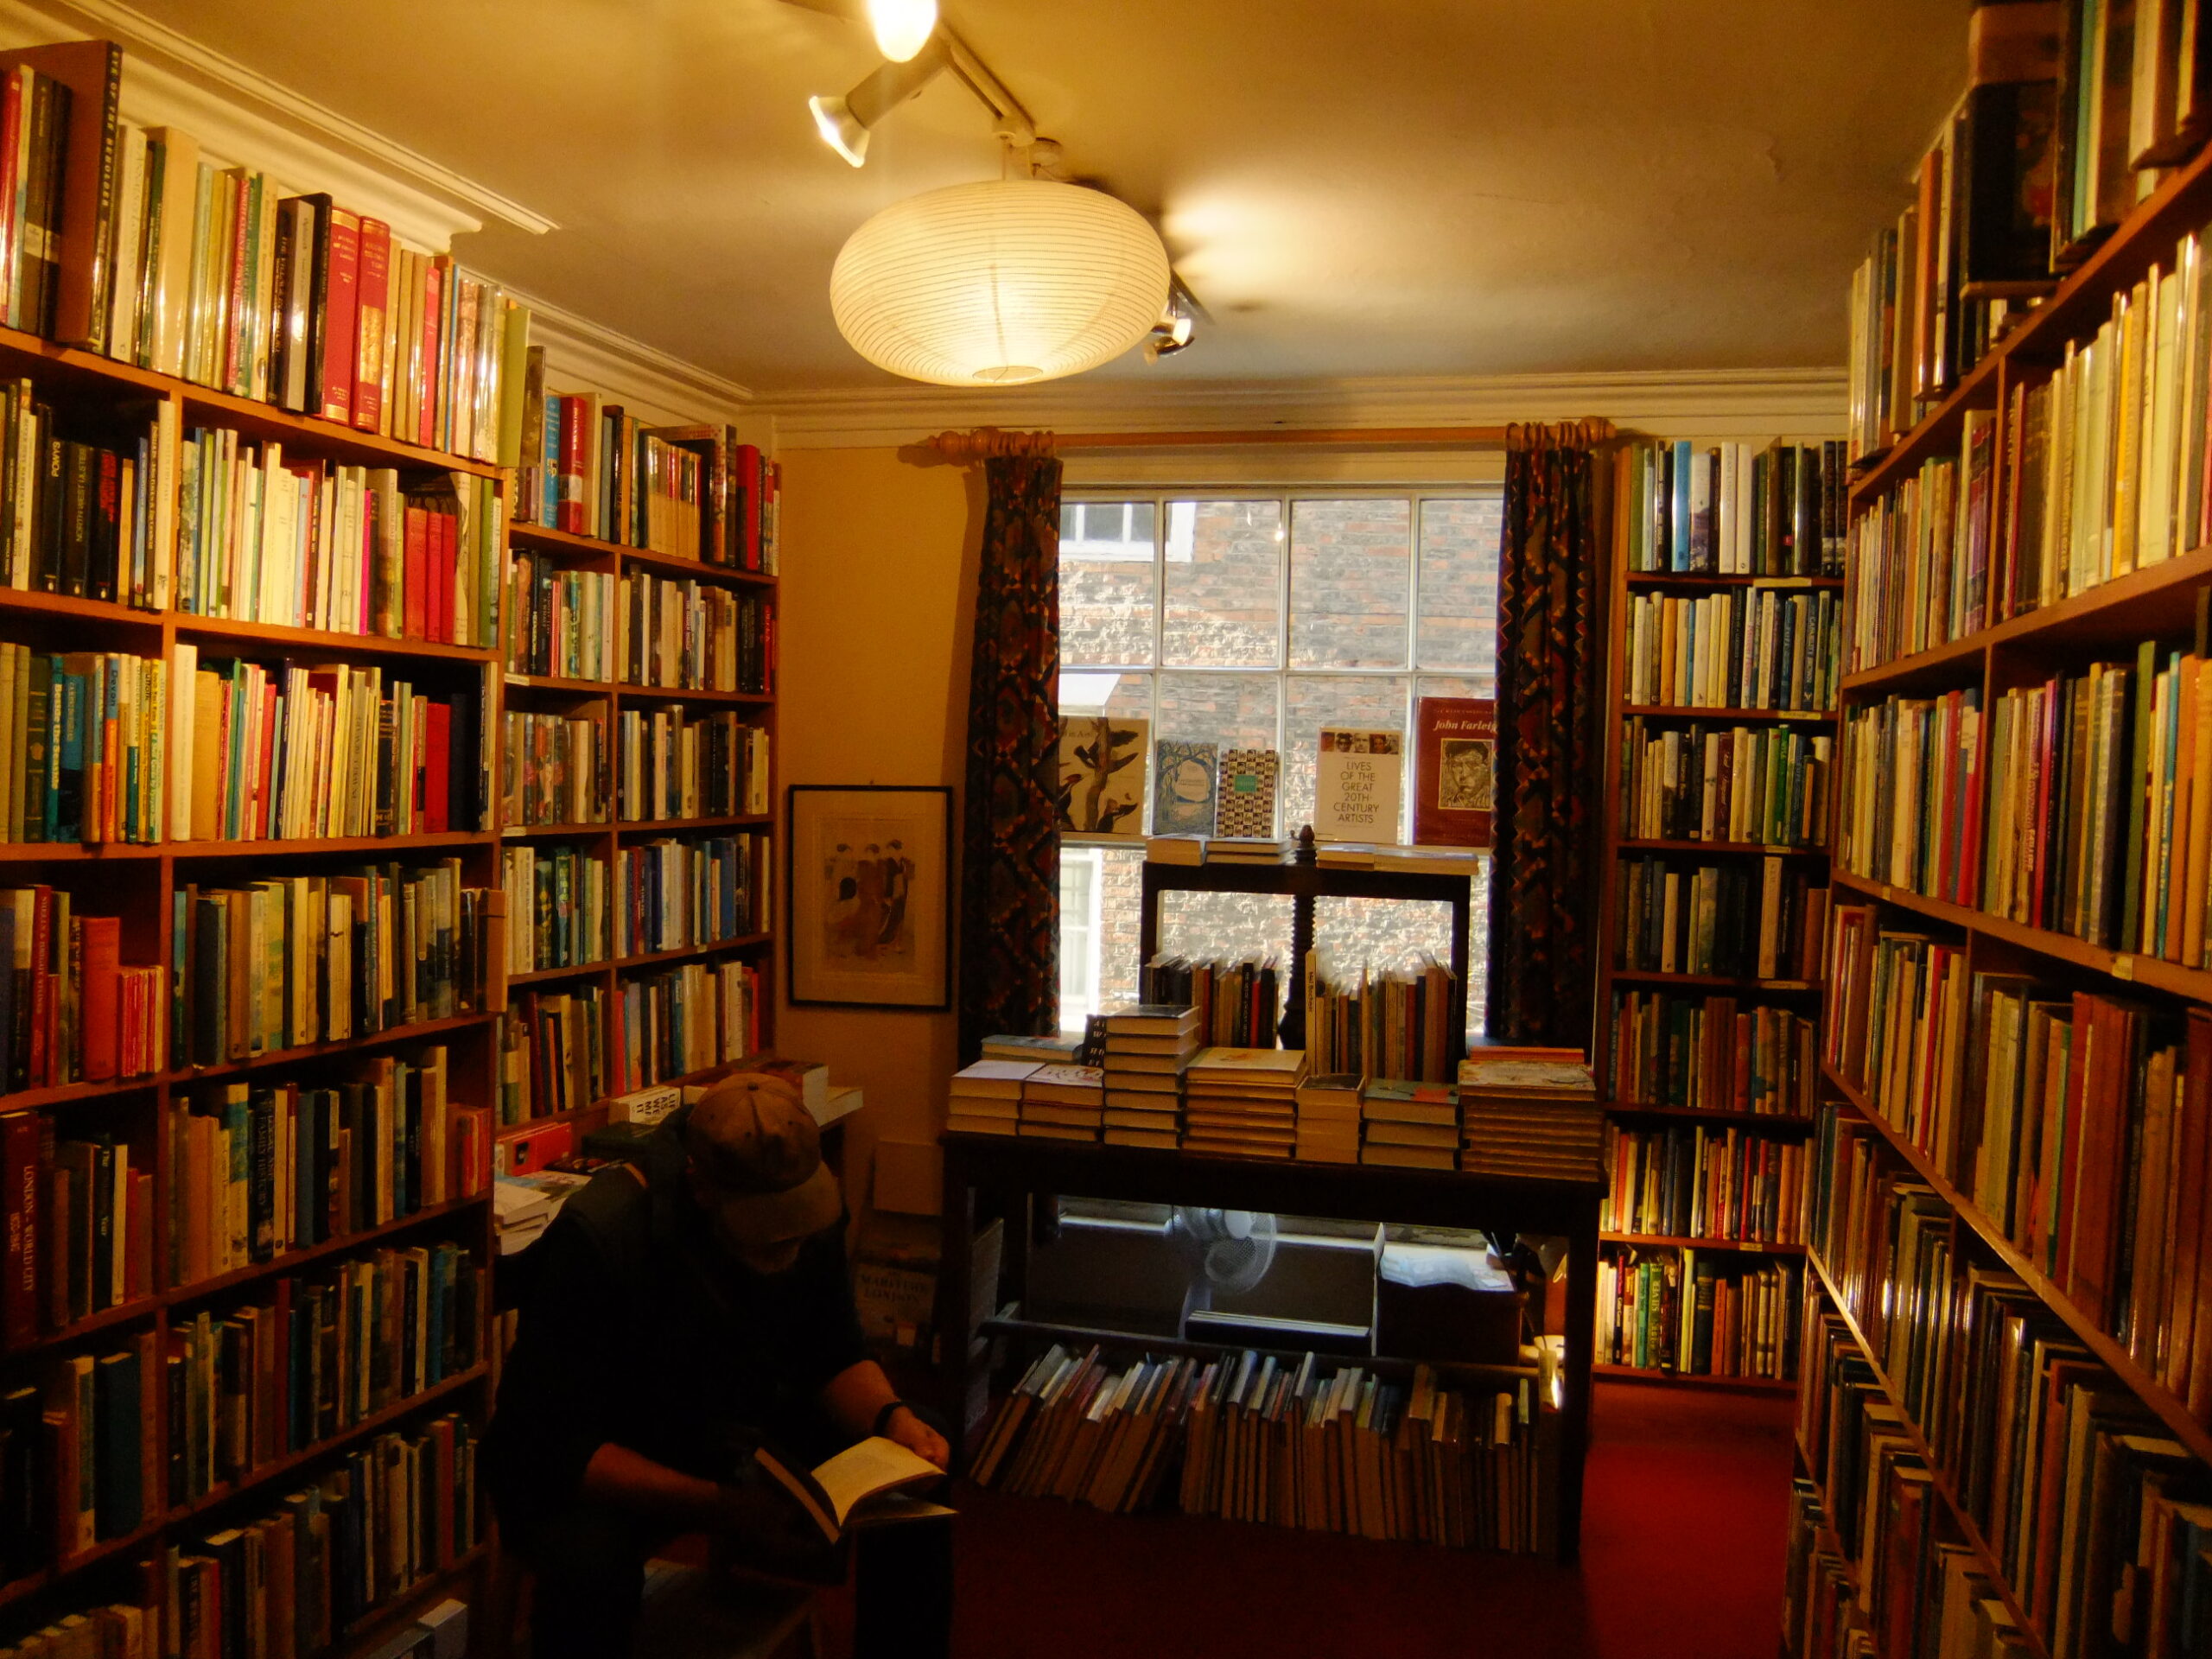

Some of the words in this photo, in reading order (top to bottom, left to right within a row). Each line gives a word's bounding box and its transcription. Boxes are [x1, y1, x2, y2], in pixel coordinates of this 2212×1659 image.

[109, 82, 118, 99] OF
[107, 106, 116, 131] THE
[102, 137, 114, 207] BEHOLDER
[51, 441, 60, 477] POWYS
[53, 724, 61, 745] the
[1433, 720, 1458, 731] John
[1340, 771, 1355, 781] OF
[1357, 772, 1376, 782] THE
[1346, 761, 1371, 771] LIVES
[1341, 781, 1374, 792] GREAT
[1333, 802, 1379, 812] CENTURY
[1338, 813, 1374, 823] ARTISTS
[23, 1165, 35, 1213] LONDON
[22, 1224, 35, 1264] WORLD
[22, 1266, 35, 1291] CITY
[1650, 1281, 1661, 1312] SILVER
